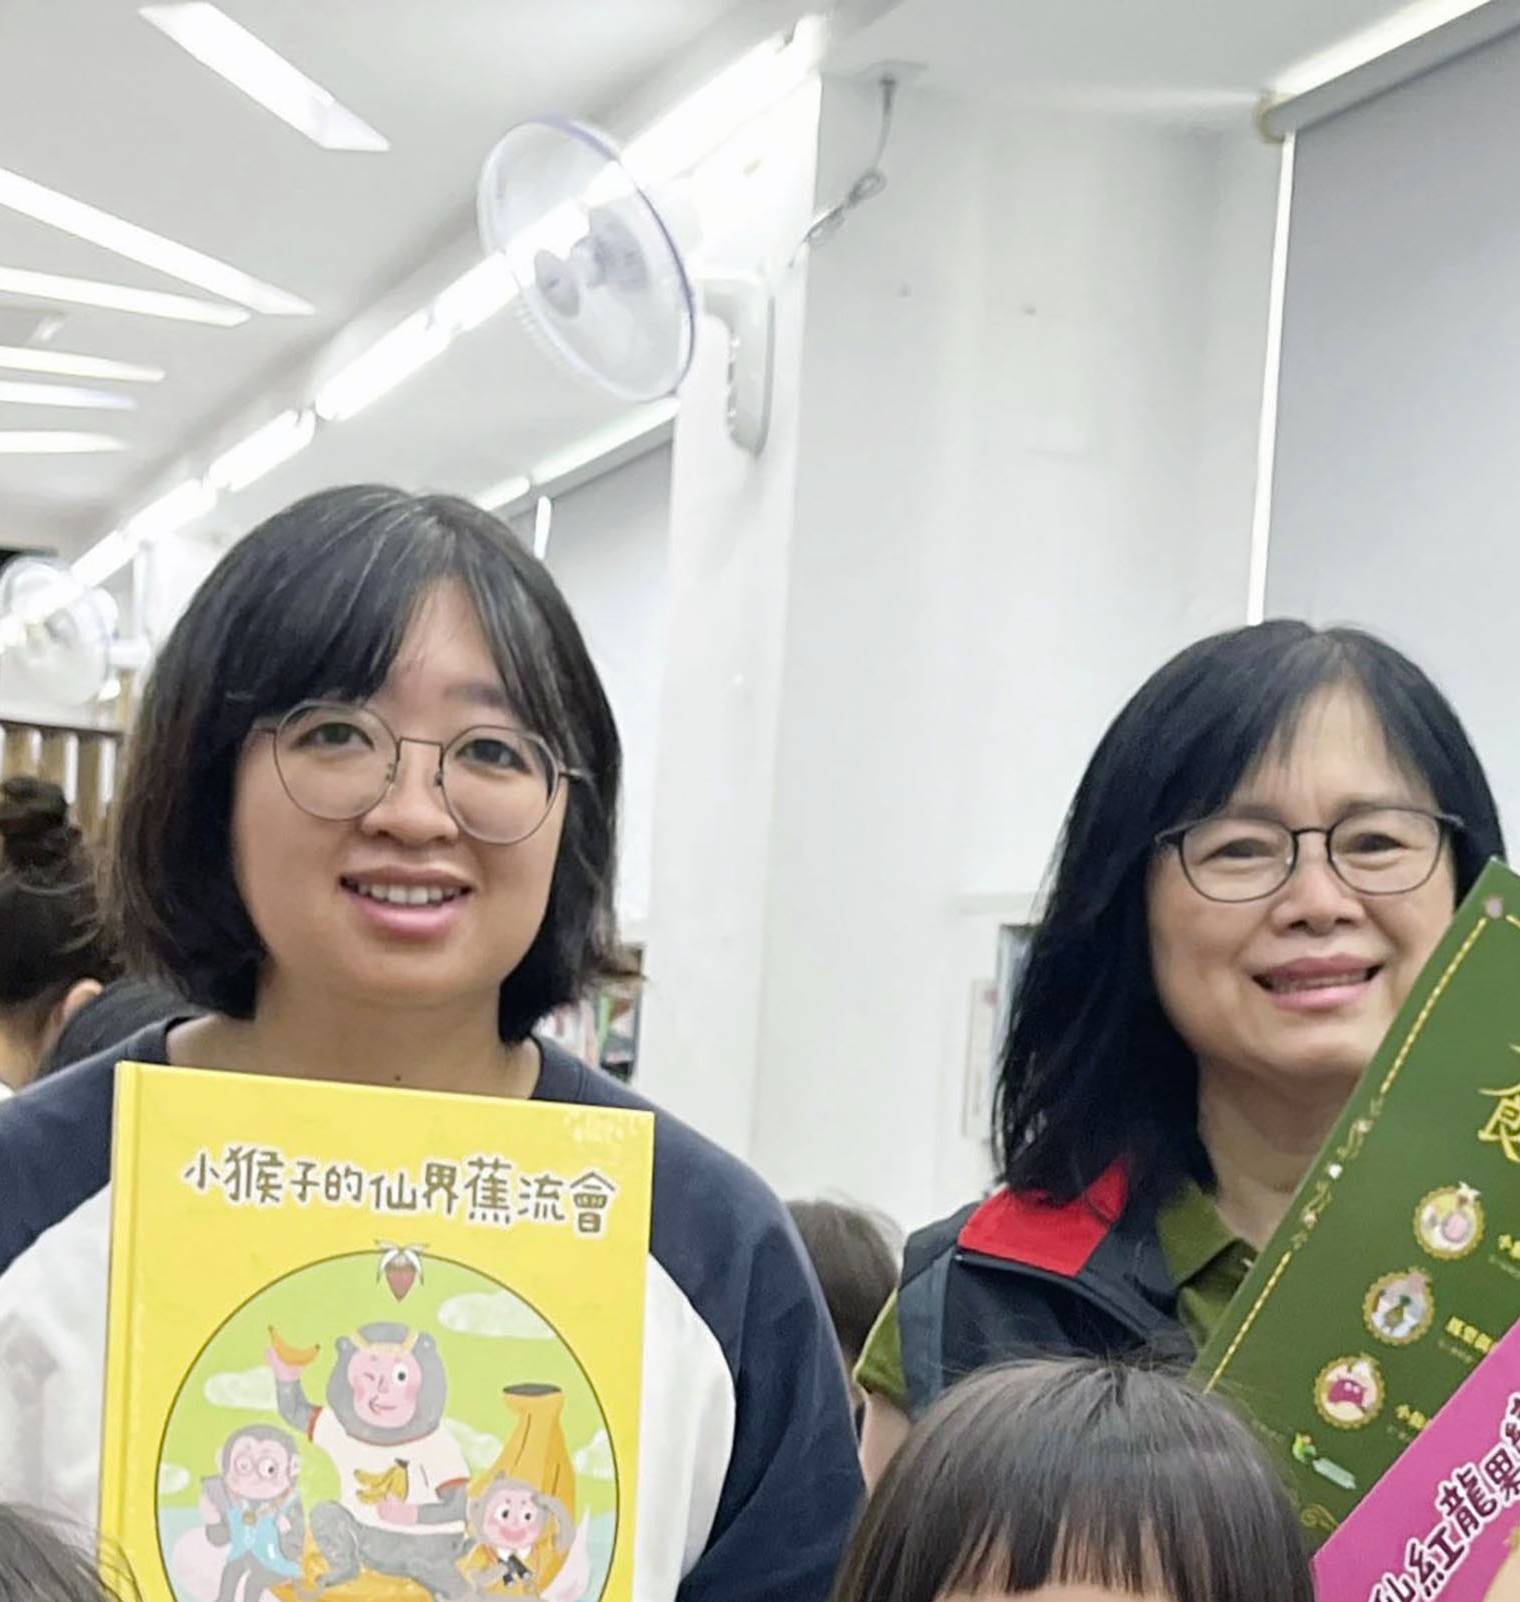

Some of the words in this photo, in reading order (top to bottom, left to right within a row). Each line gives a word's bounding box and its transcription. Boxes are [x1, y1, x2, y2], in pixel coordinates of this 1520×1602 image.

[183, 1145, 616, 1234] 小猴子的仙界蕉流會
